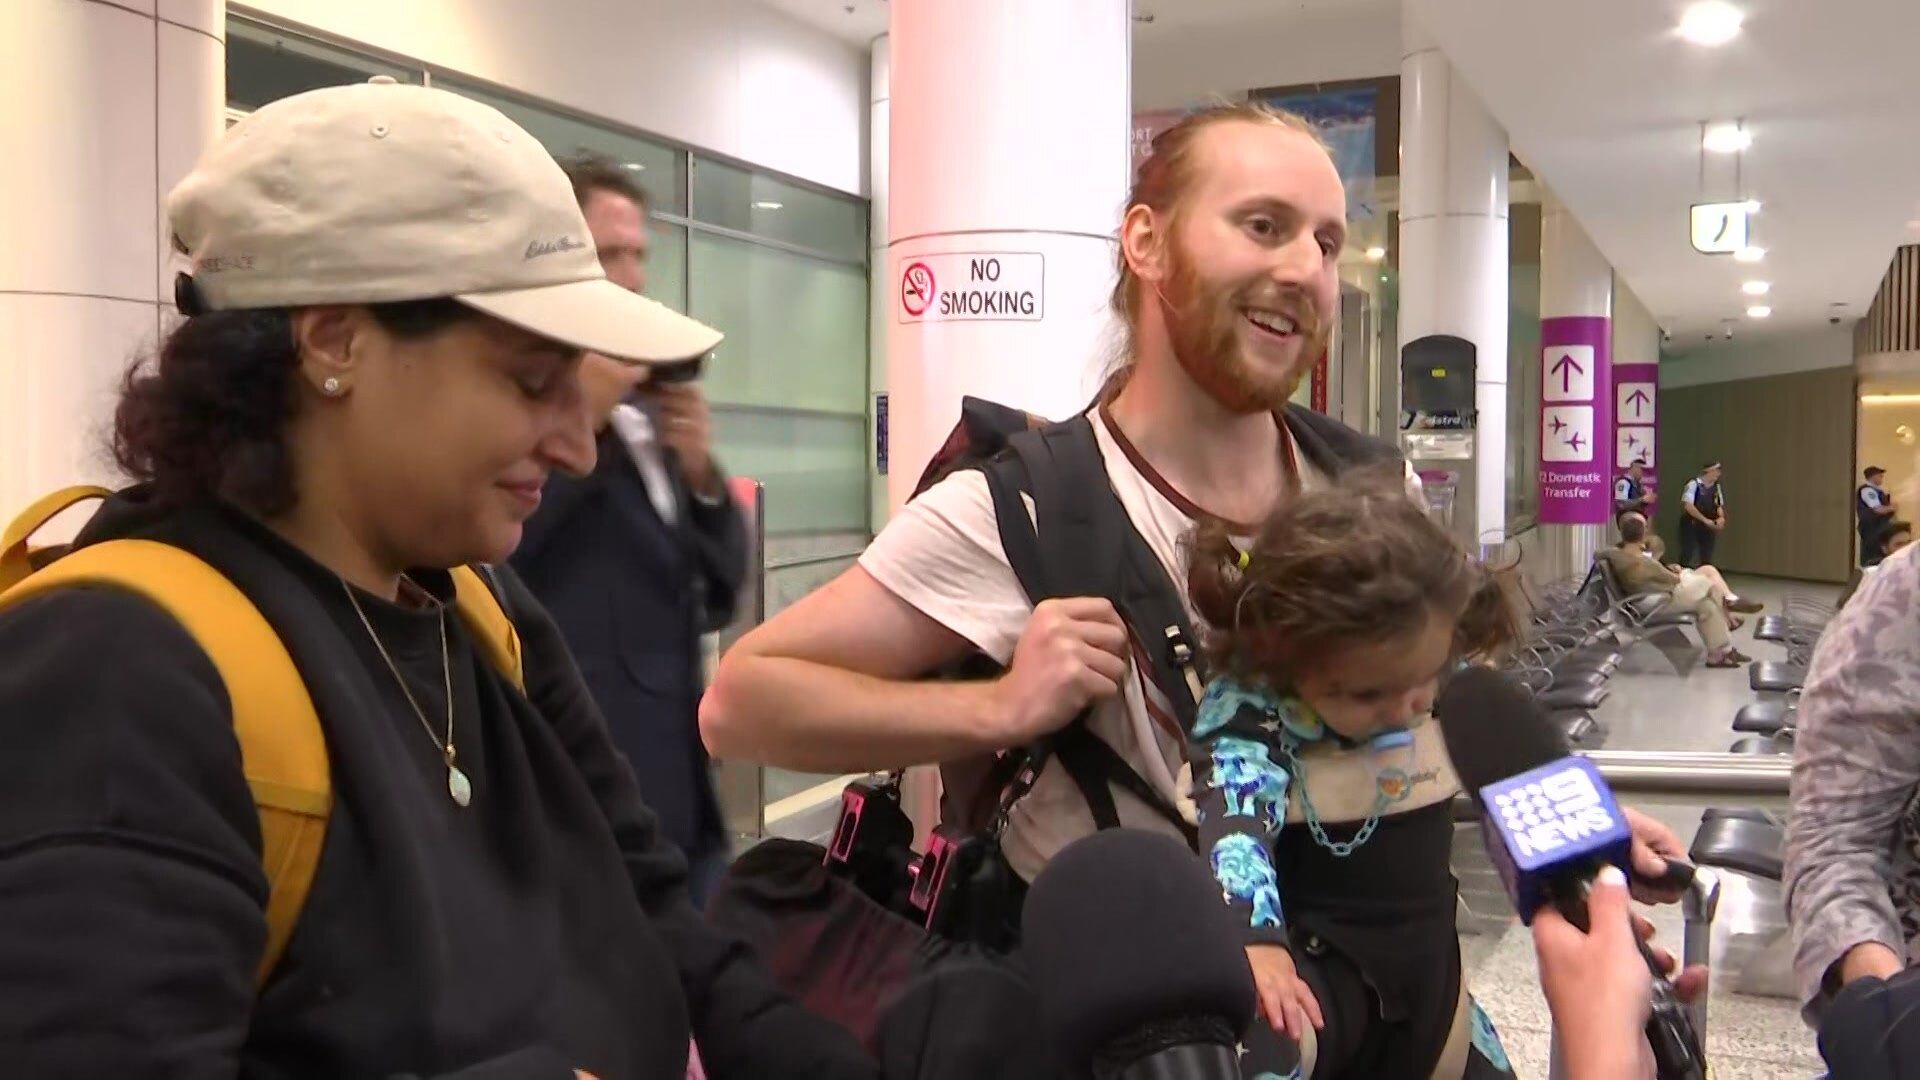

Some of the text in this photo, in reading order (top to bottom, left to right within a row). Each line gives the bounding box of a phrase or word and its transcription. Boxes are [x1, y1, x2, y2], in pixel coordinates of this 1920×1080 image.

[971, 258, 1001, 282] NO
[940, 291, 1035, 315] SMOKING
[1548, 471, 1602, 484] Domestic
[1545, 486, 1592, 499] Transfer
[1540, 767, 1601, 816] 9
[1513, 805, 1614, 858] NEWS
